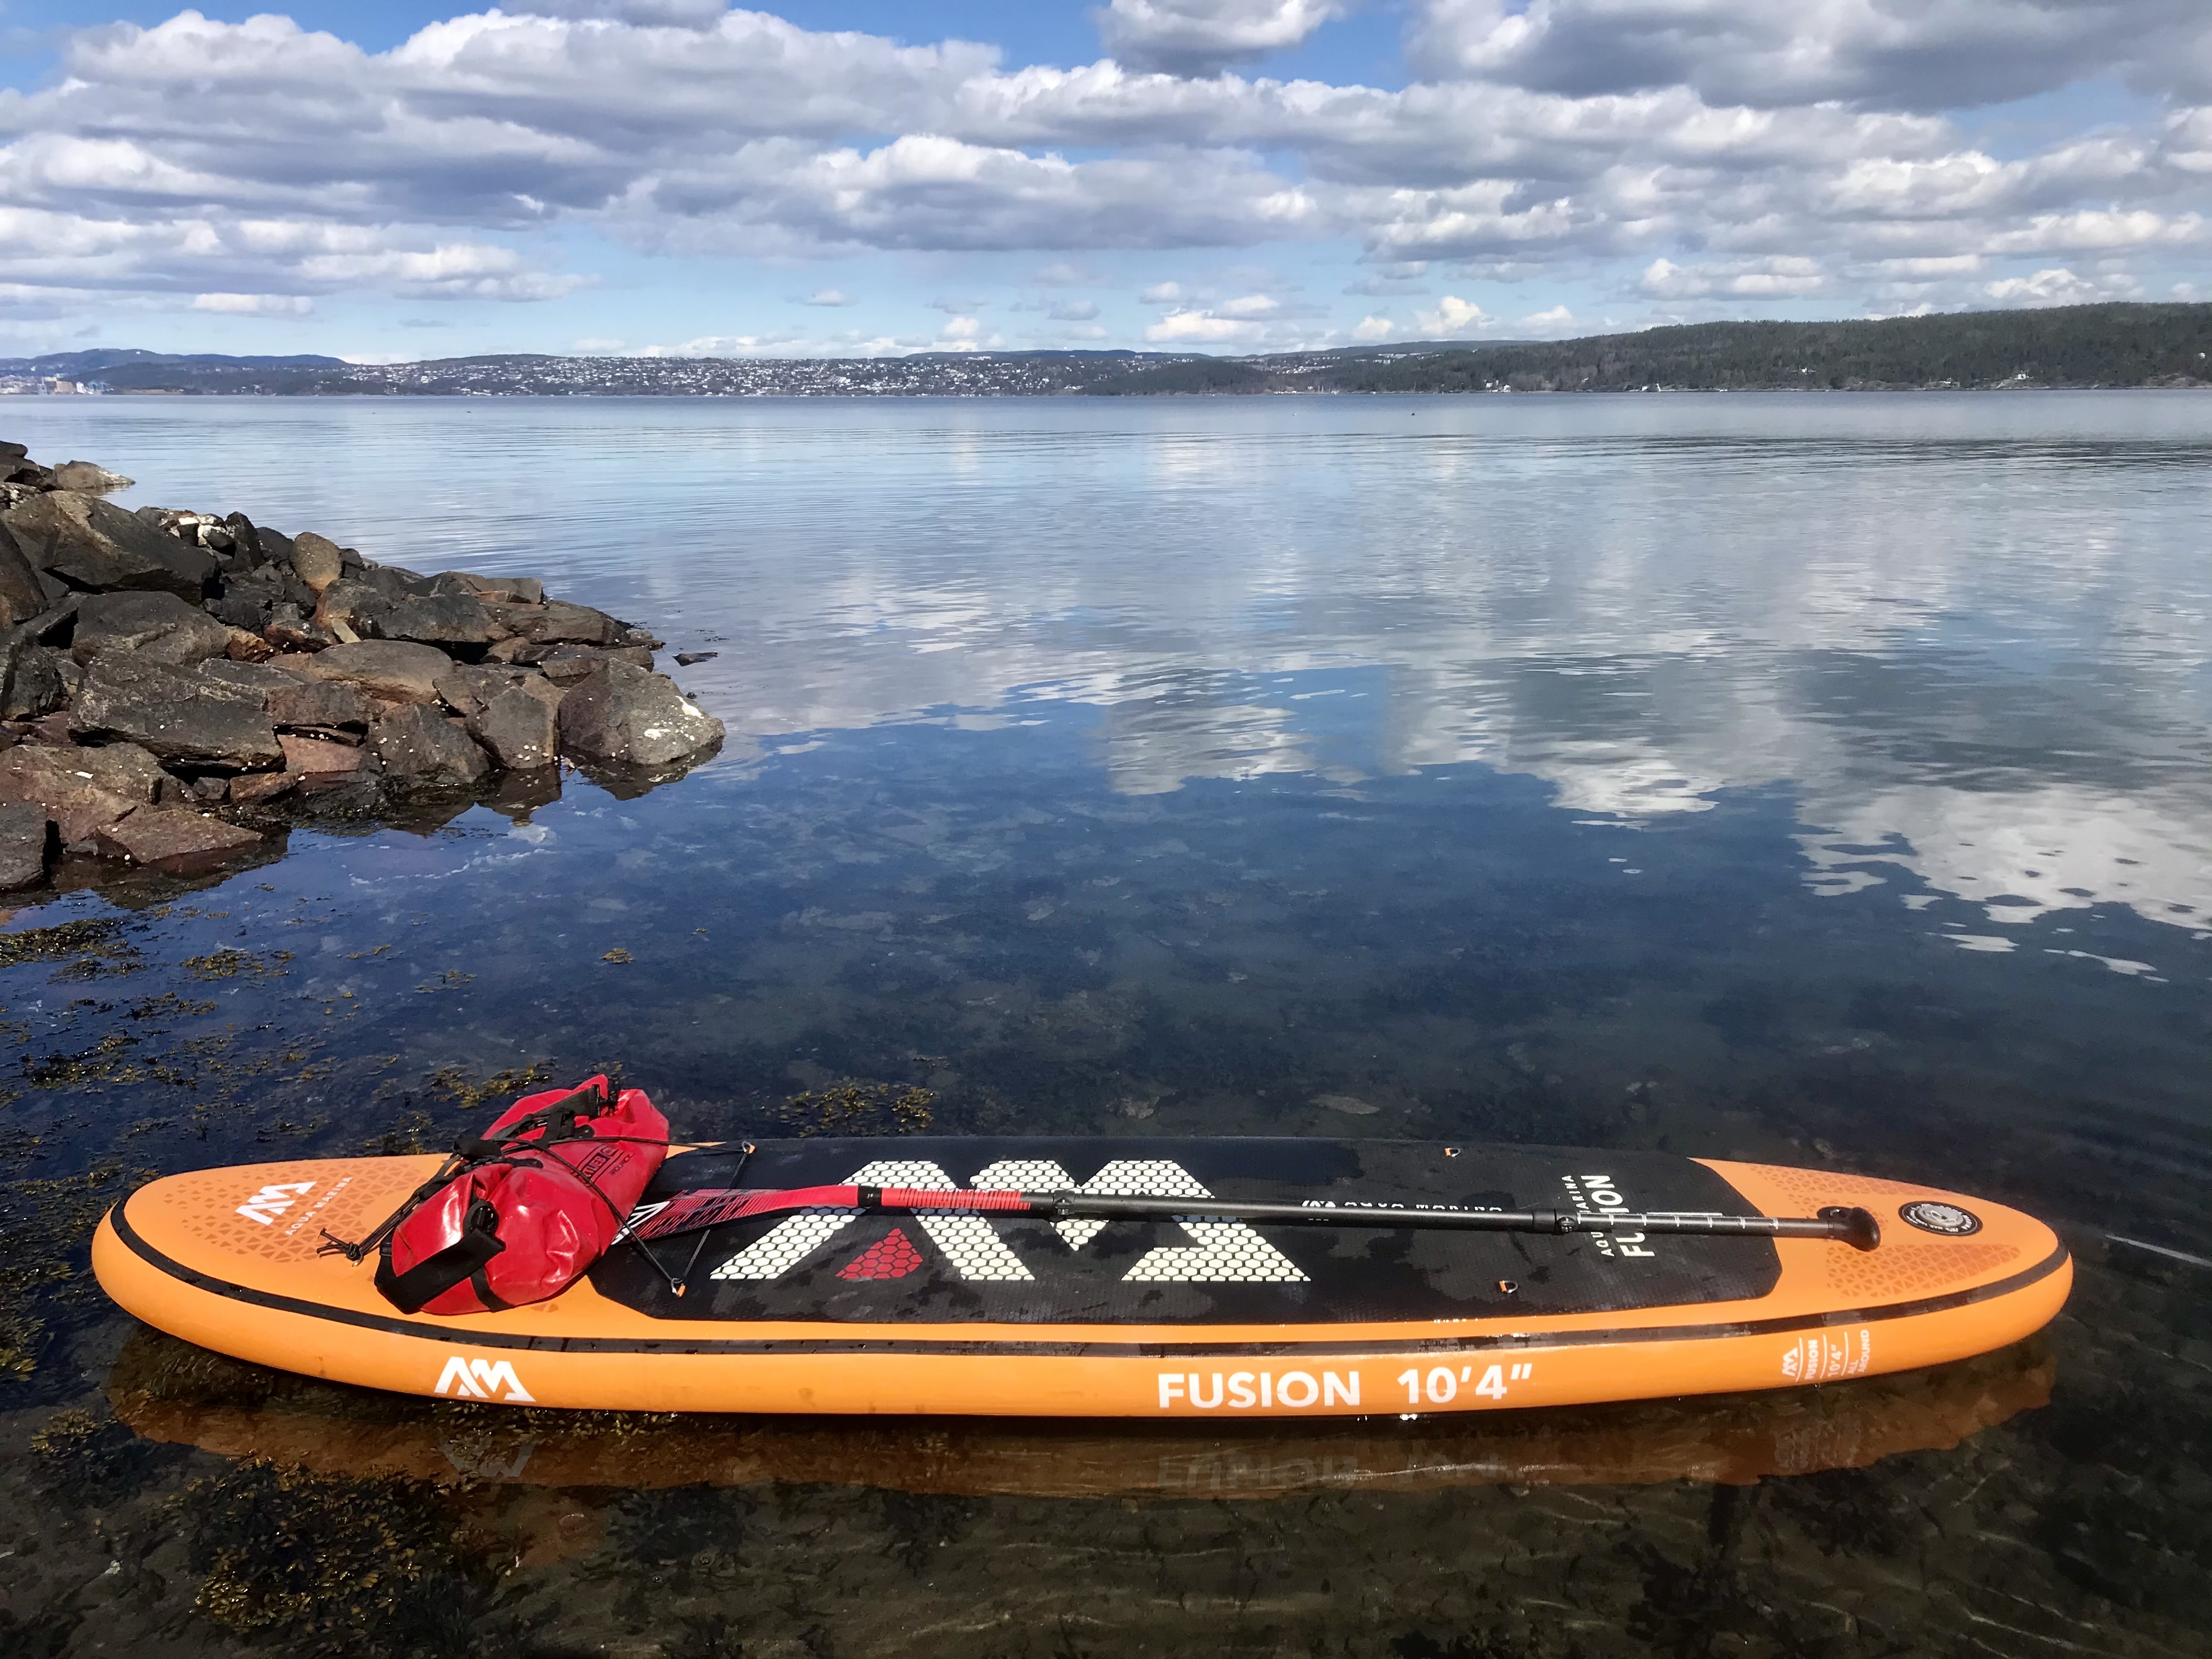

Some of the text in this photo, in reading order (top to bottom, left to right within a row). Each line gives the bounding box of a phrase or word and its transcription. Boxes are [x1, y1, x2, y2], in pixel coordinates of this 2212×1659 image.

[285, 1177, 353, 1235] AQUA MARINA
[1561, 1175, 1615, 1257] AQU ARINA
[1581, 1175, 1655, 1256] FUION
[1804, 1339, 1819, 1380] FUSION
[1847, 1359, 1859, 1374] ALL
[1858, 1329, 1870, 1372] AROUND
[1158, 1372, 1361, 1408] FUSION
